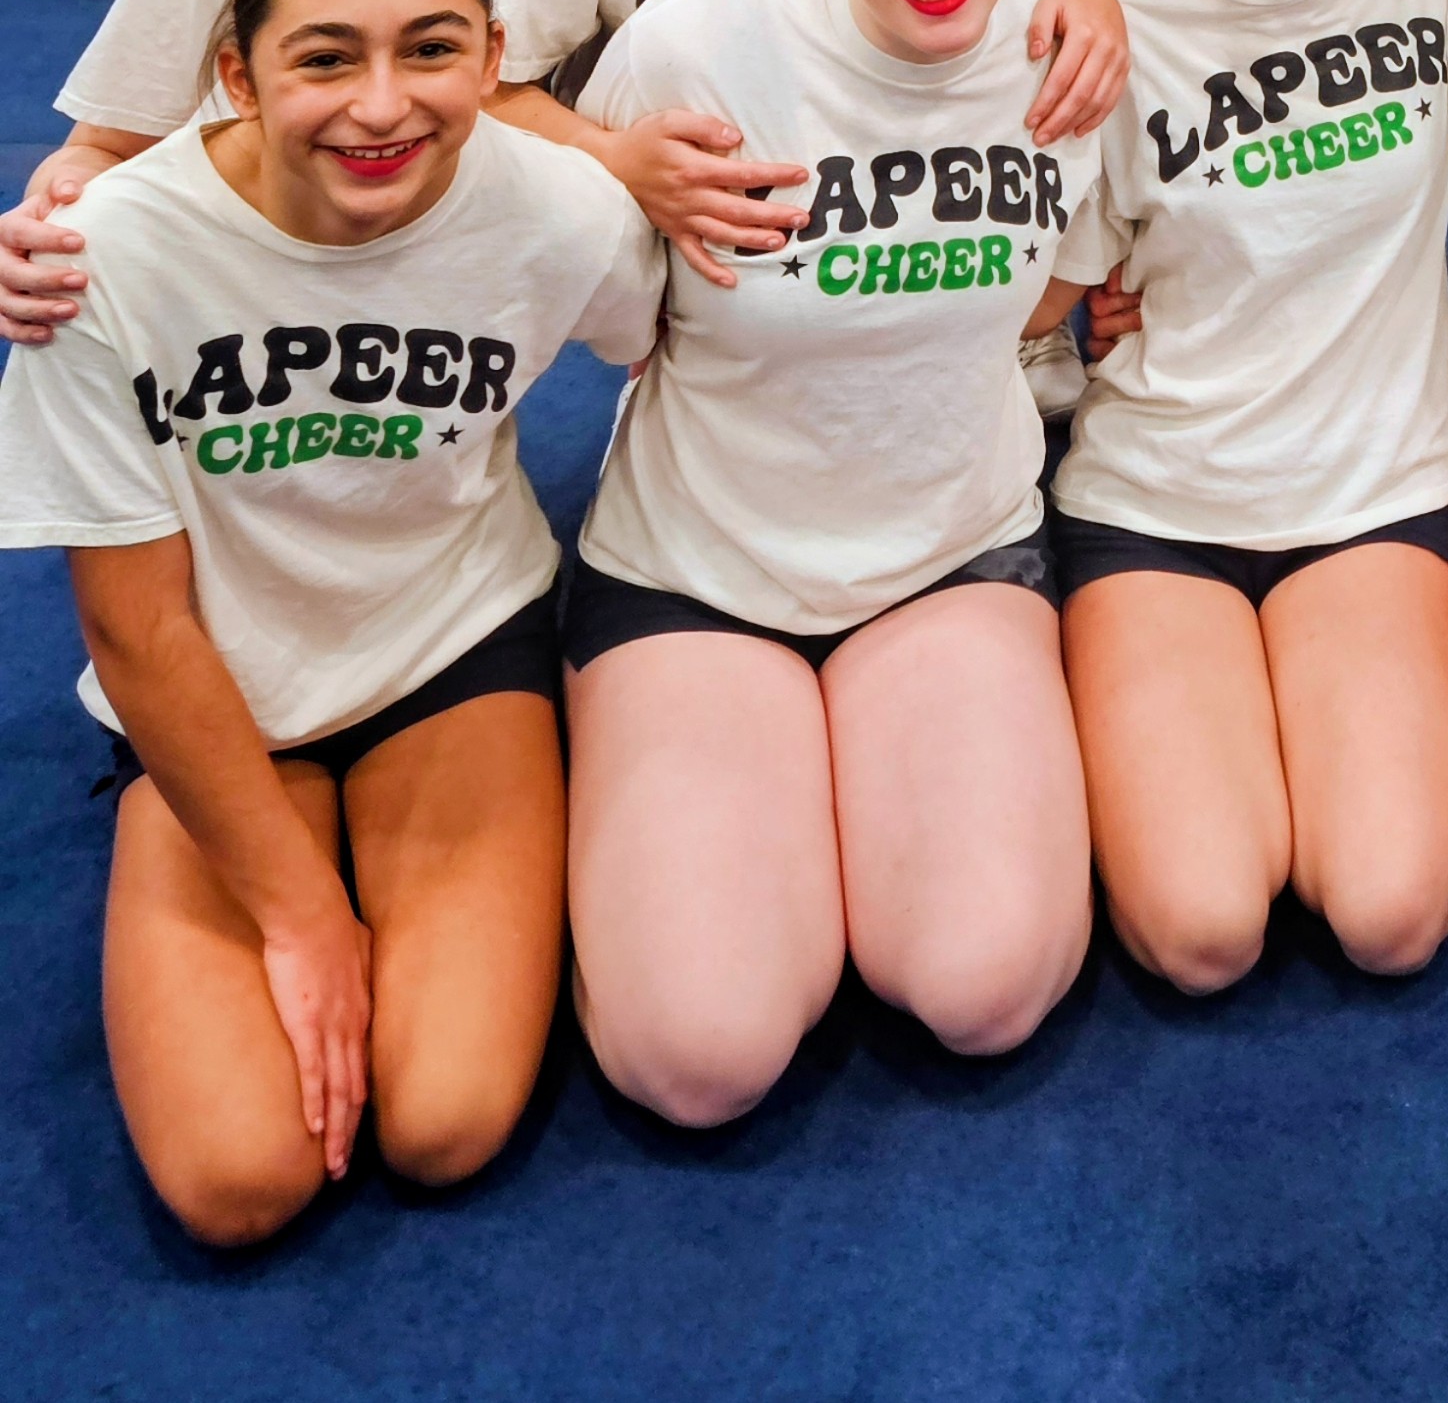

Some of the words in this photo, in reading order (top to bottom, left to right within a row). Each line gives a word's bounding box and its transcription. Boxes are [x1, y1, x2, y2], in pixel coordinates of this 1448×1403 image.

[1147, 17, 1448, 184] LAPEER
[1233, 101, 1413, 188] CHEER
[817, 234, 1013, 295] CHEER
[133, 323, 516, 446] LAPEER
[197, 412, 424, 475] CHEER
